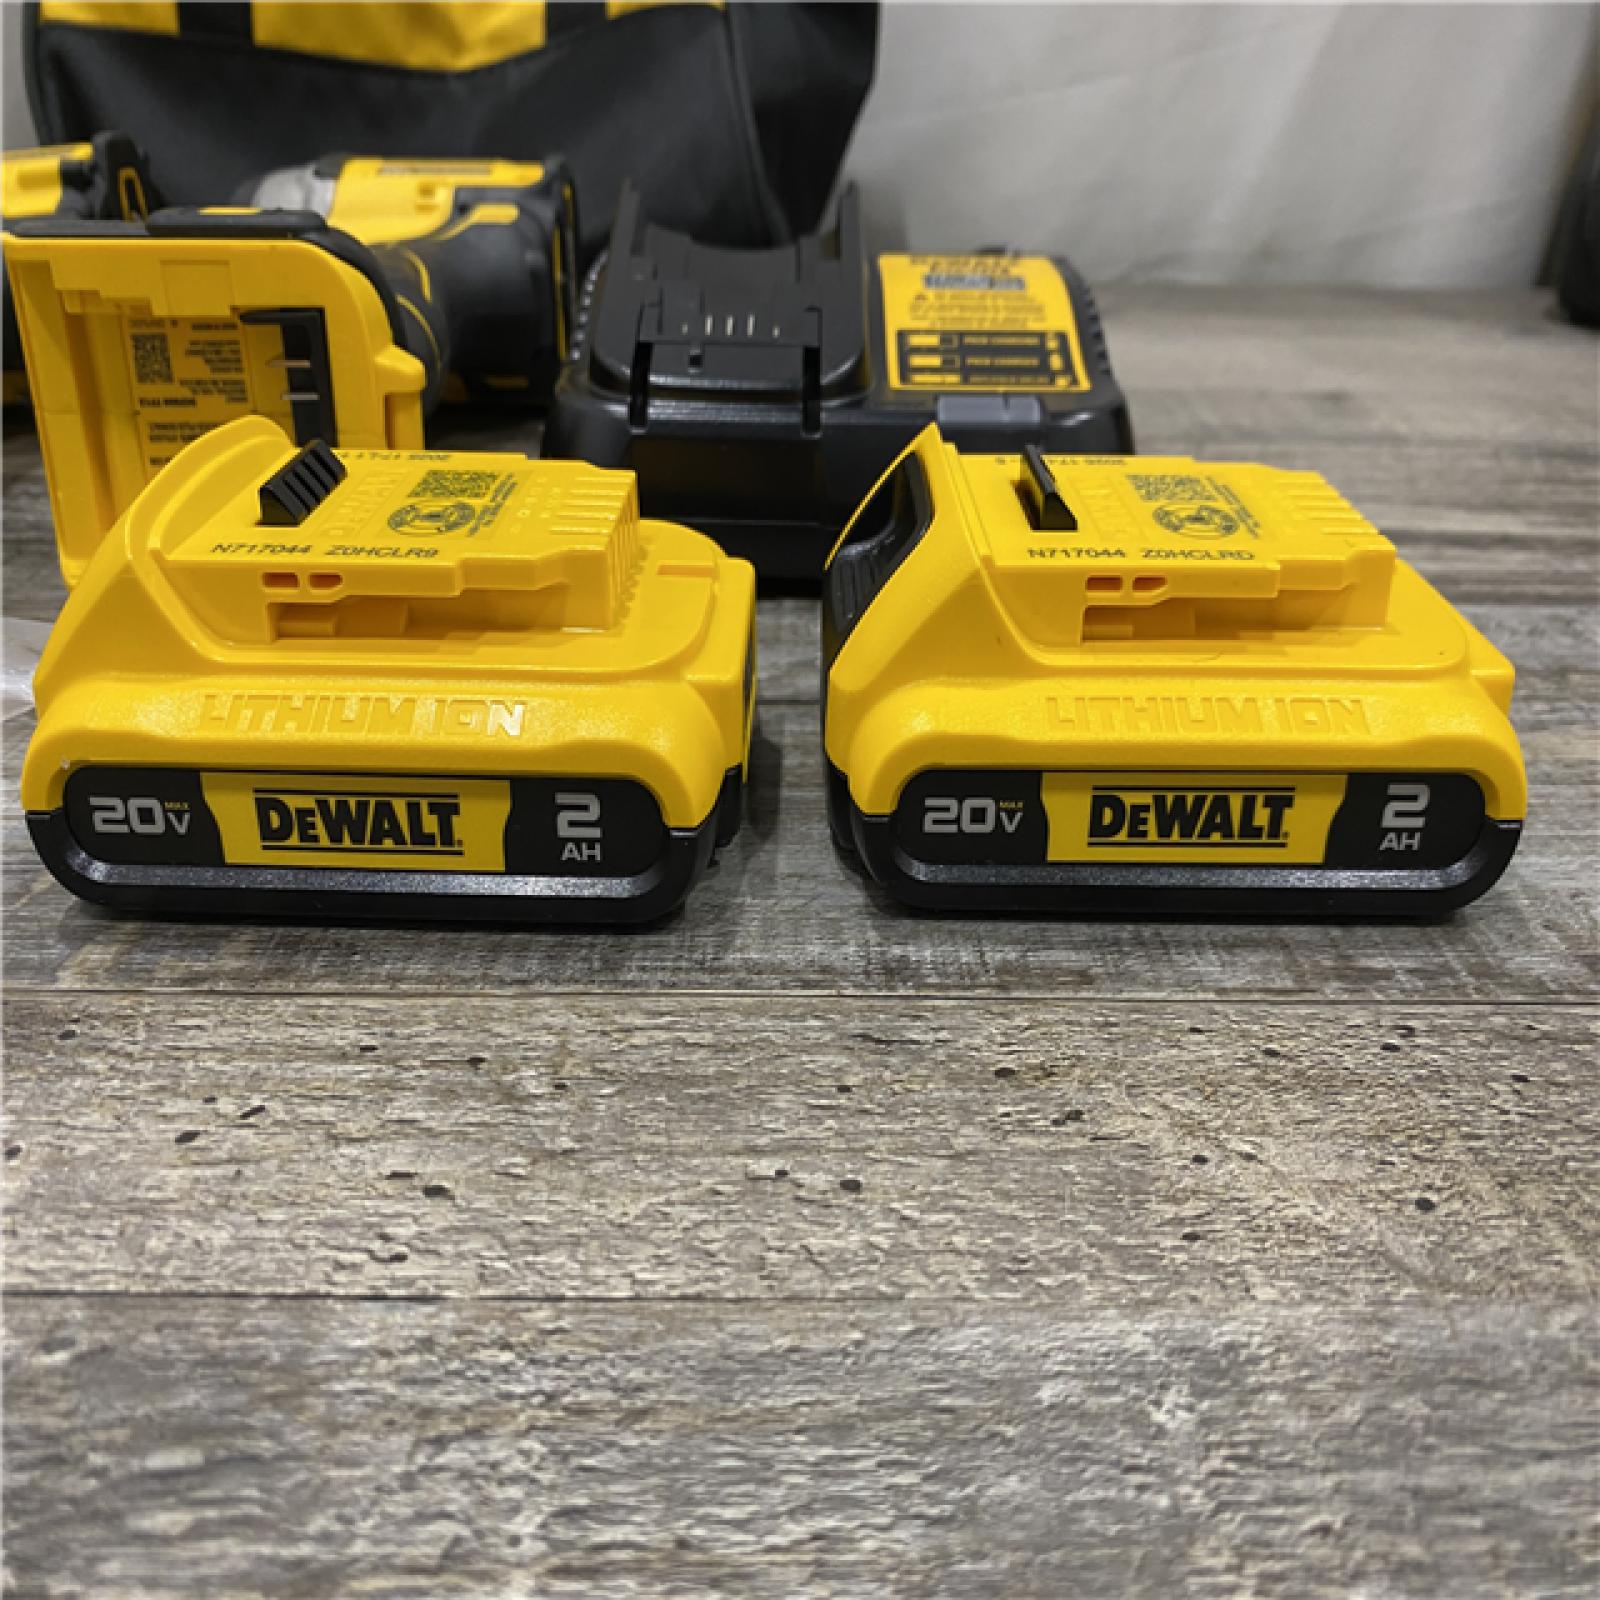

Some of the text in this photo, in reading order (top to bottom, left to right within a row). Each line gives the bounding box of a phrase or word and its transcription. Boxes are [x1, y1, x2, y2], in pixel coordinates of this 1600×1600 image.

[200, 694, 526, 737] LITHIUM ION
[1046, 696, 1369, 735] LITHIUM ION
[554, 792, 602, 838] 2
[1381, 782, 1430, 828] 2
[561, 841, 601, 862] AH
[1379, 831, 1421, 851] AH
